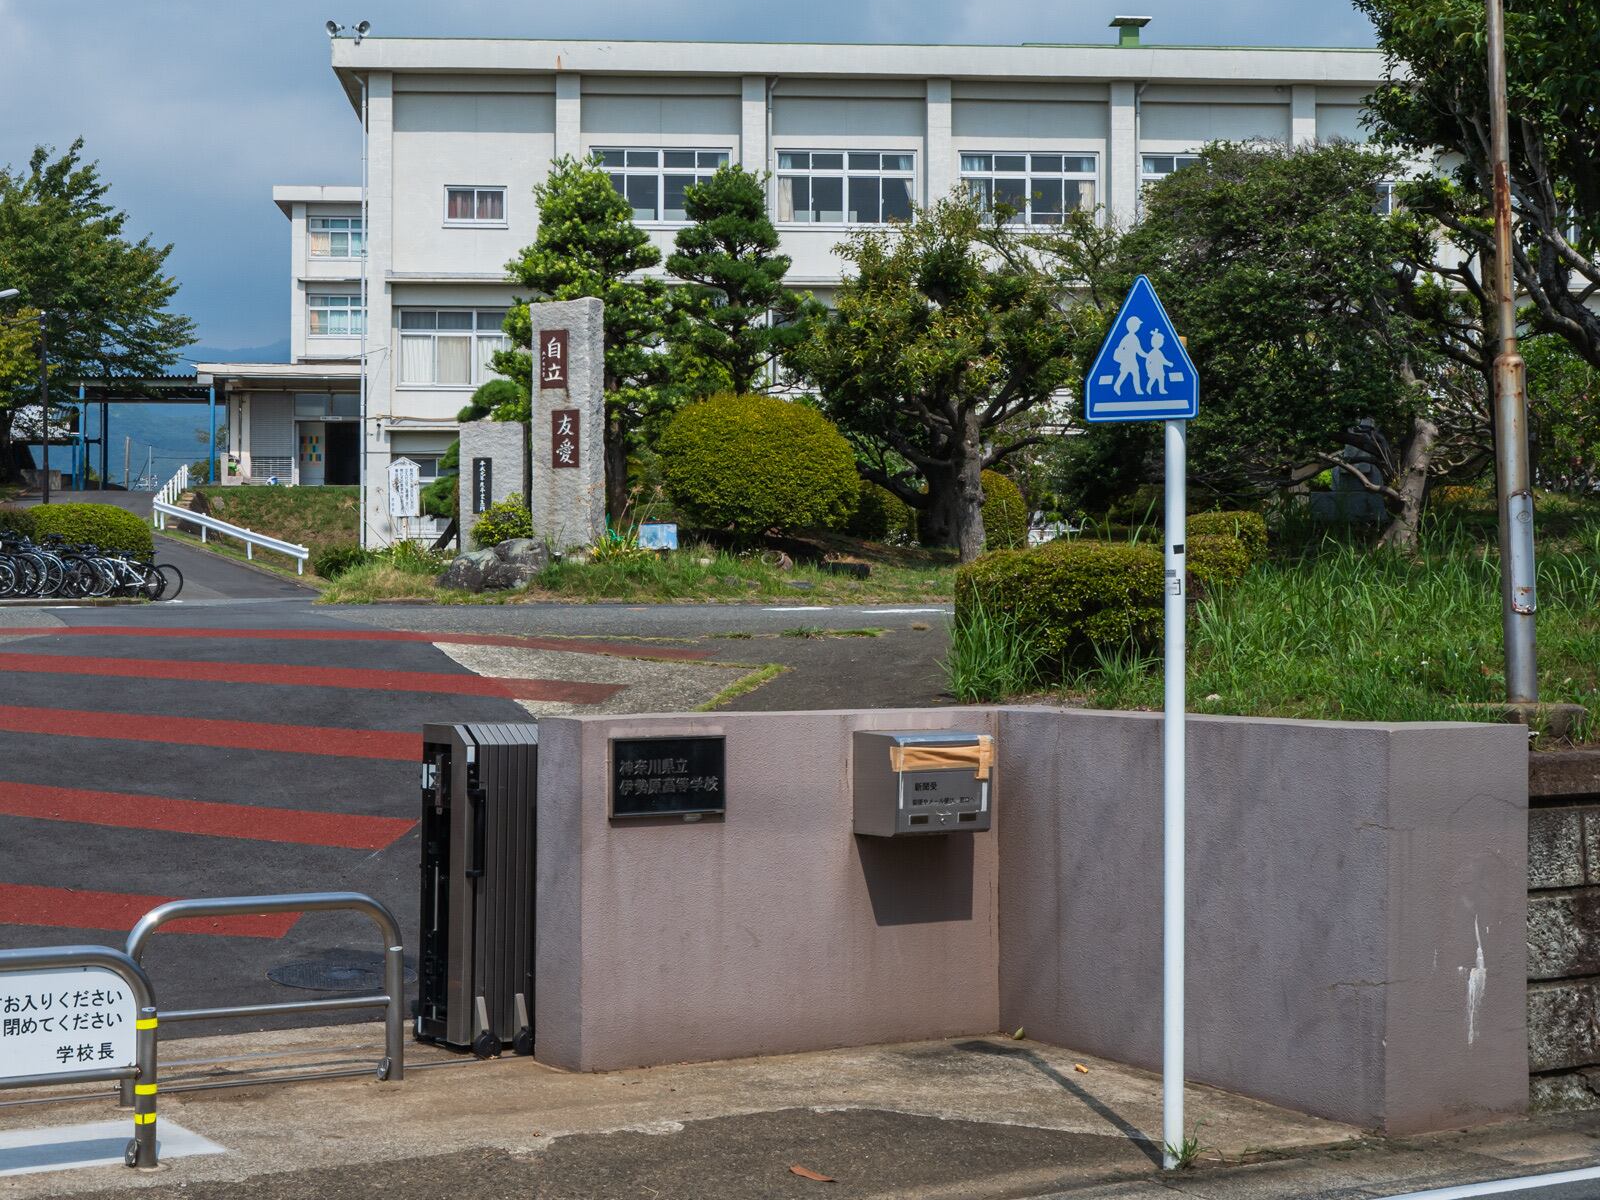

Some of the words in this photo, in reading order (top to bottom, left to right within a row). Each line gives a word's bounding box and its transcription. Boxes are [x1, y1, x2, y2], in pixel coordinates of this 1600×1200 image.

[544, 336, 564, 382] 自立
[555, 413, 575, 464] 友愛
[619, 758, 688, 776] 神奈川県立
[619, 775, 719, 796] 伊勢原高等学校
[0, 989, 123, 1014] お入りください
[3, 1012, 123, 1037] 閉めてください
[56, 1042, 115, 1064] 学校長
